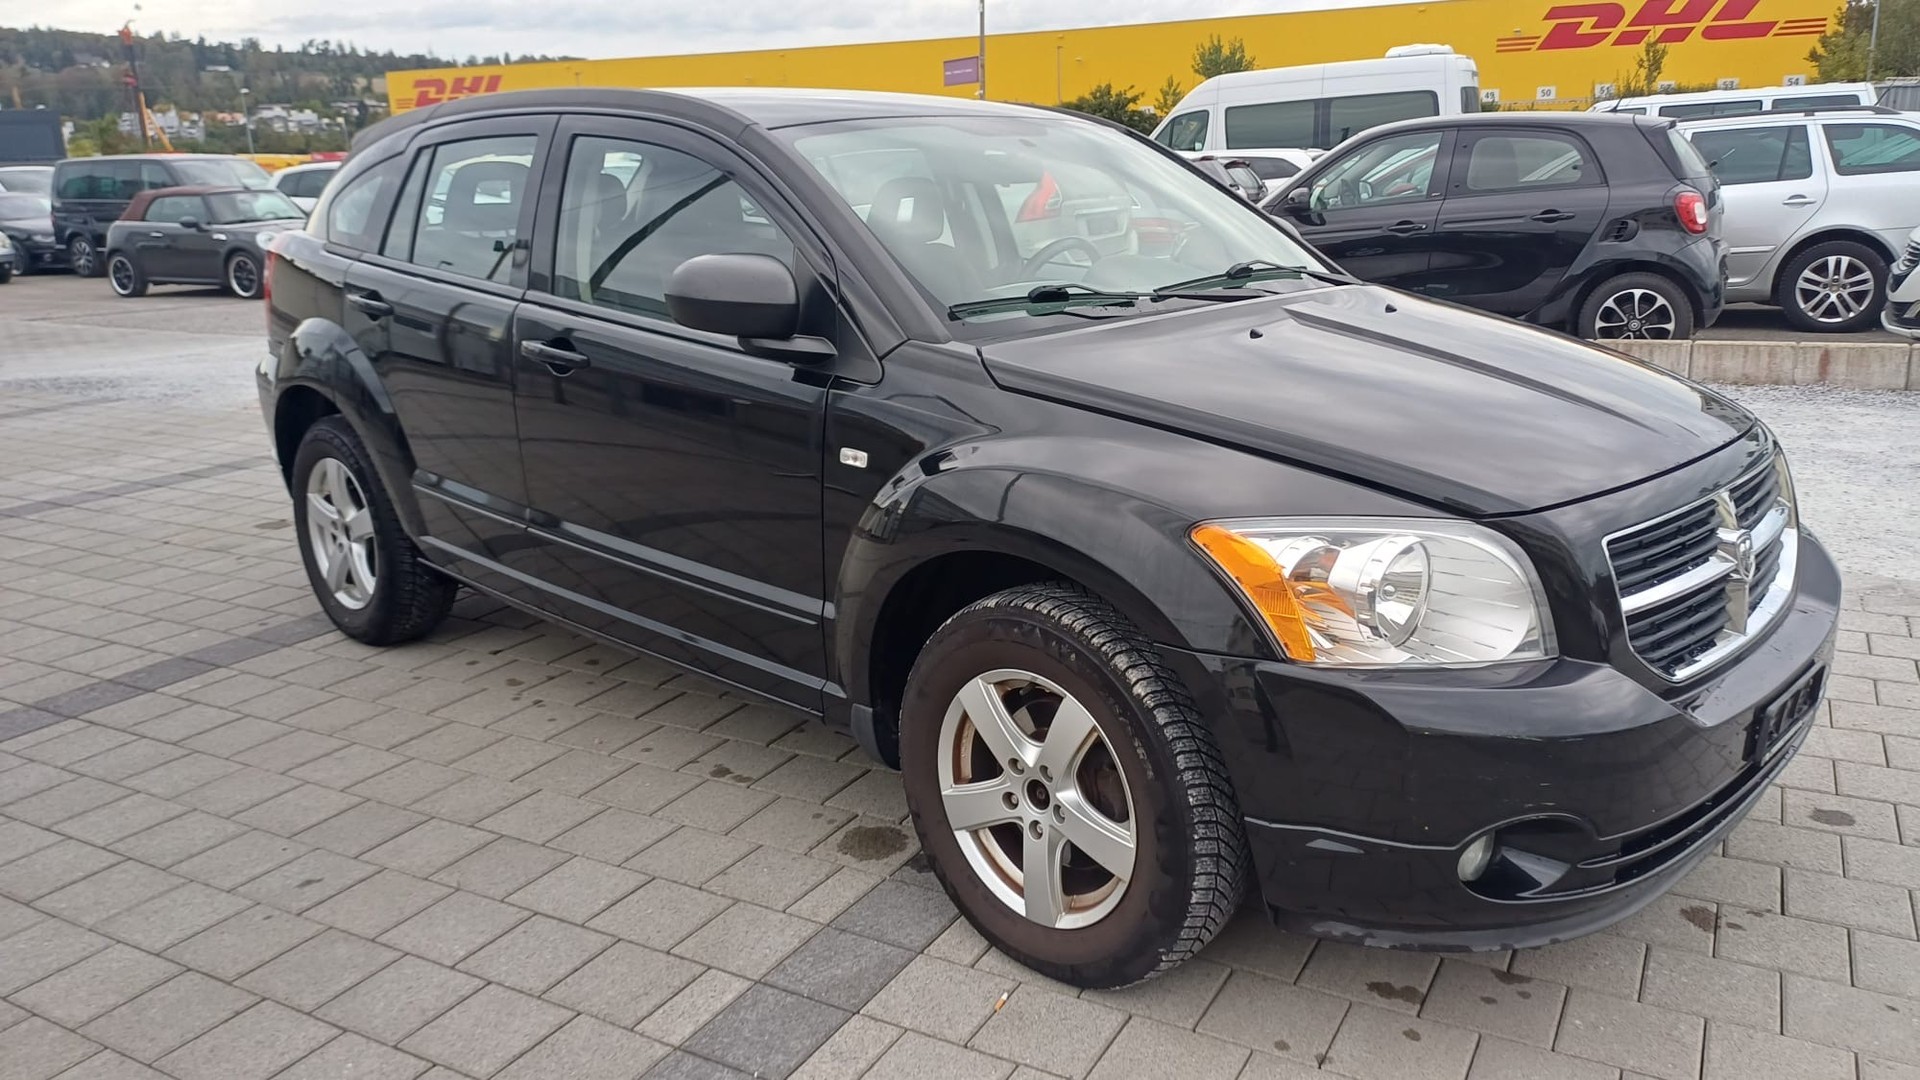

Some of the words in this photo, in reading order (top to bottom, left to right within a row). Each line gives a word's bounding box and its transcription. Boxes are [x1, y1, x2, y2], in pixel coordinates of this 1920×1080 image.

[1536, 0, 1779, 50] DHL
[1721, 80, 1735, 90] 53
[1786, 77, 1800, 87] 54
[1484, 91, 1496, 100] 49
[1540, 88, 1552, 98] 50
